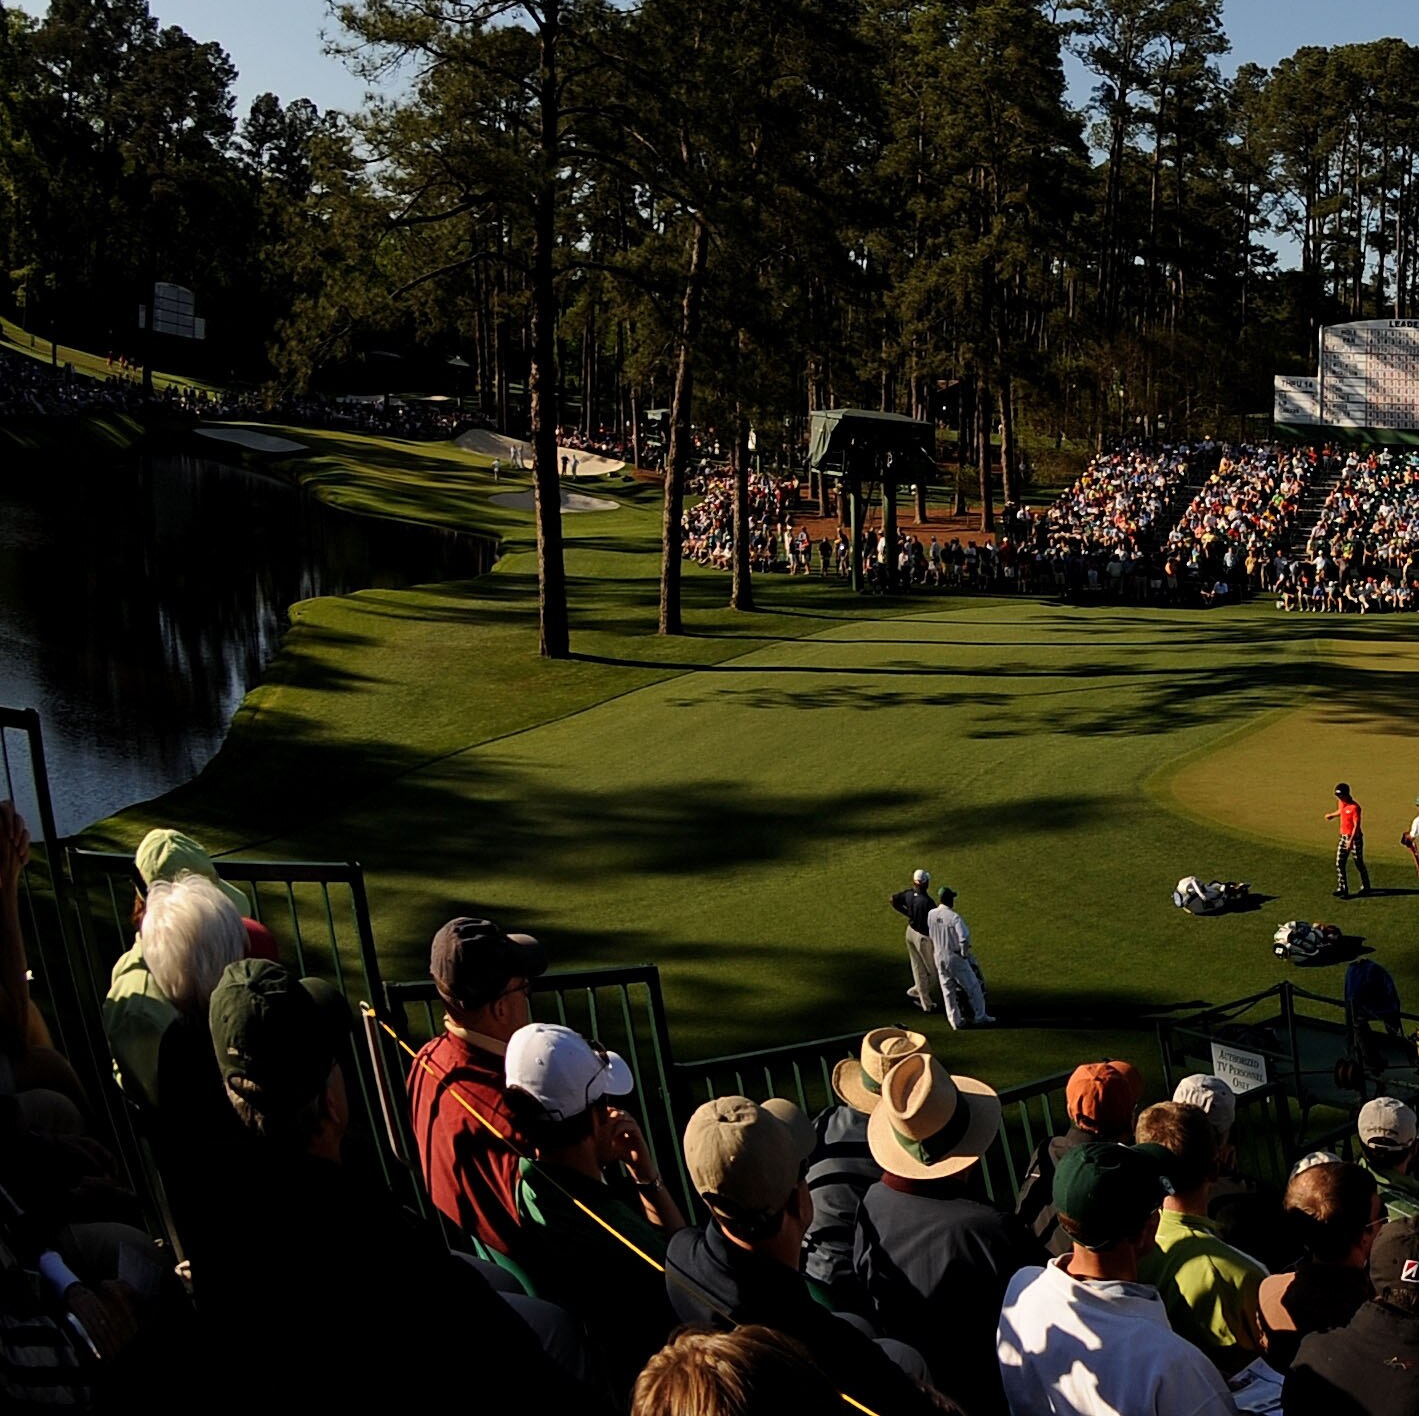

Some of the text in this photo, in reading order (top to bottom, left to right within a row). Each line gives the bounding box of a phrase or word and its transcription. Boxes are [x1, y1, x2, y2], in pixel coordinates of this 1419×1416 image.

[1281, 379, 1302, 388] THRU
[1217, 1060, 1265, 1083] TV PERSONNEL
[1232, 1077, 1250, 1091] ONLY
